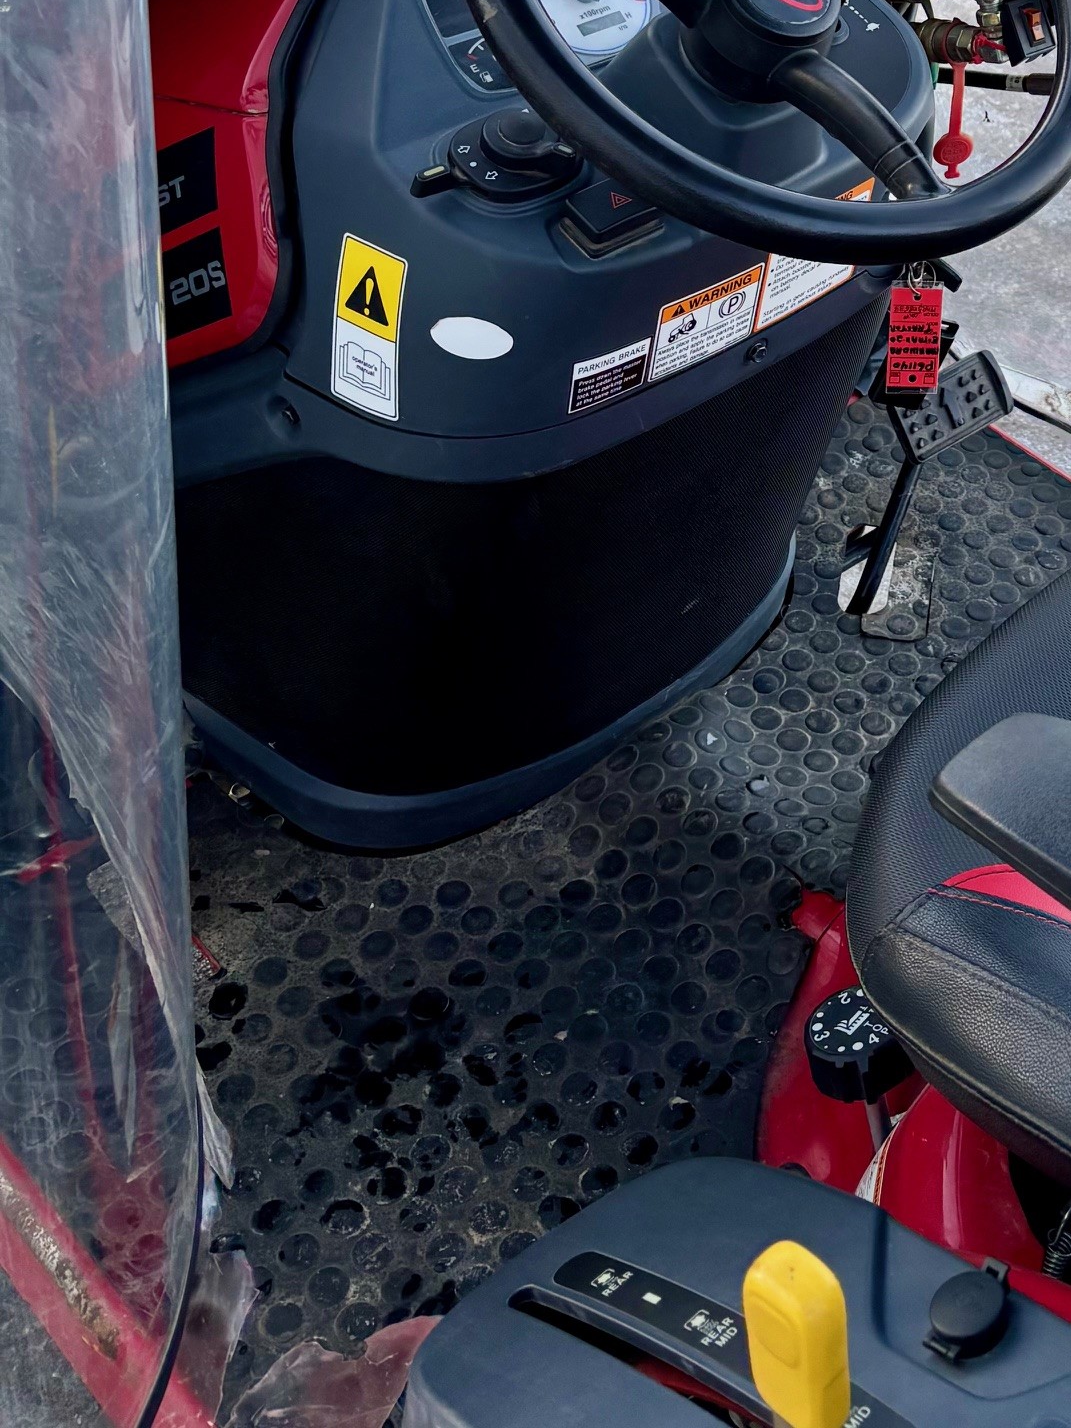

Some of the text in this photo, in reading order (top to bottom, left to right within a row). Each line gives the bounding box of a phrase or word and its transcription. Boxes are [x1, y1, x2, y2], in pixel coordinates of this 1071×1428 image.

[579, 5, 611, 20] x100rpm
[470, 64, 480, 73] E
[773, 273, 790, 285] Attach
[792, 261, 812, 275] booster
[774, 262, 797, 278] terminal
[780, 275, 799, 287] battery
[801, 265, 815, 276] decal
[169, 260, 226, 306] 20S
[690, 274, 751, 309] WARNING
[727, 295, 739, 313] P
[764, 303, 784, 317] Starting
[793, 291, 805, 302] gear
[807, 279, 826, 293] causing
[762, 316, 771, 324] can
[773, 306, 788, 317] result
[798, 291, 815, 304] serious
[656, 351, 677, 364] position
[690, 339, 704, 348] apply
[716, 325, 734, 337] parking
[736, 318, 749, 327] brake
[658, 346, 674, 355] Always
[676, 340, 689, 349] place
[700, 322, 728, 337] transmission
[690, 345, 705, 354] Failure
[735, 325, 748, 333] cause
[352, 356, 378, 371] operator's
[578, 344, 645, 374] PARKING BRAKE
[679, 358, 688, 366] and
[893, 360, 934, 371] P61140
[356, 364, 375, 376] manual
[597, 372, 611, 380] down
[578, 385, 594, 393] brake
[596, 377, 612, 387] pedal
[601, 380, 622, 391] parking
[624, 374, 637, 382] lever
[594, 392, 609, 400] same
[838, 992, 851, 1005] 2
[814, 1030, 830, 1042] 3
[868, 1033, 880, 1044] 4
[601, 1271, 634, 1298] REAR
[700, 1316, 734, 1347] REAR
[714, 1326, 738, 1348] MID
[844, 1405, 871, 1428] MID
